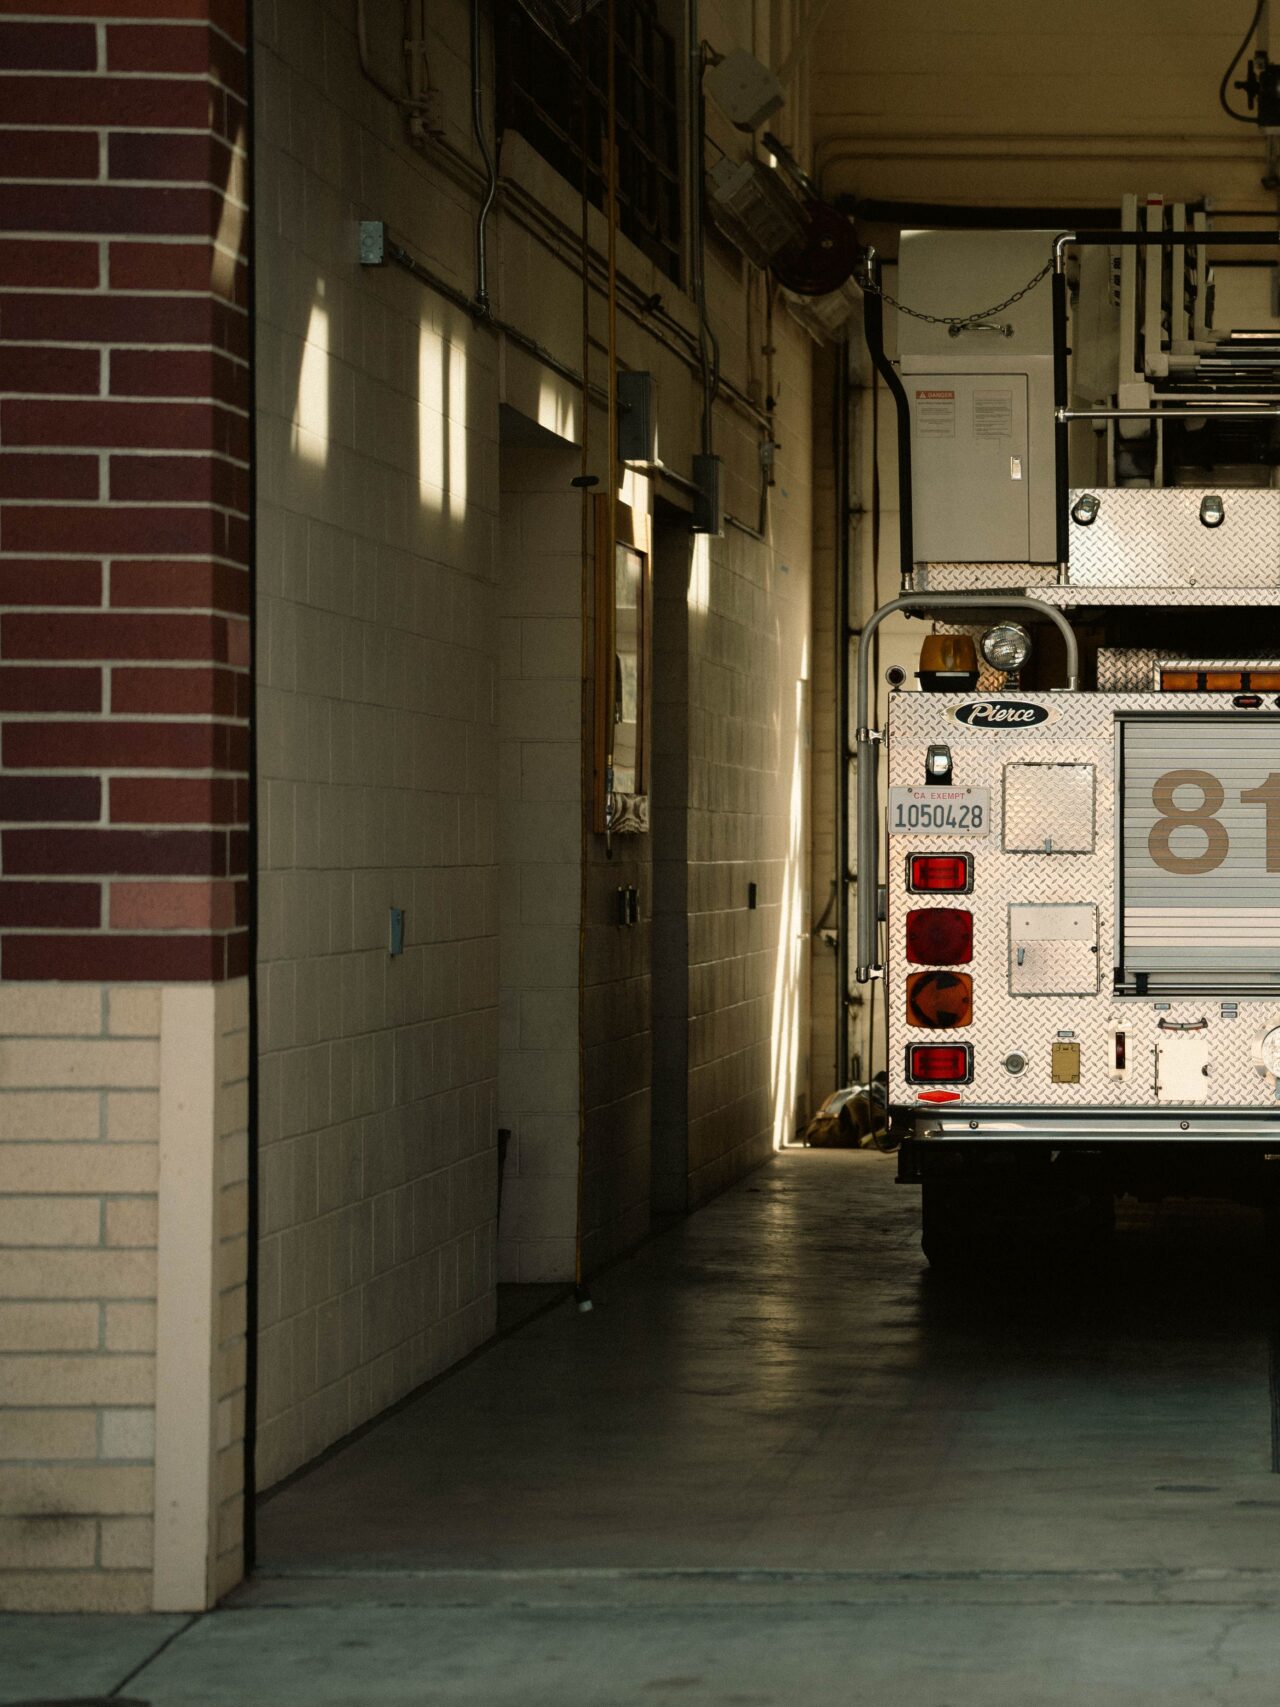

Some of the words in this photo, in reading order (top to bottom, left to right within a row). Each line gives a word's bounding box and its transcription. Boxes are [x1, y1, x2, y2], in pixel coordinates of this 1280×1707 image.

[967, 702, 1036, 725] Pierce
[913, 792, 926, 800] CA
[930, 792, 965, 800] EXEMPT
[894, 804, 983, 829] 1050428
